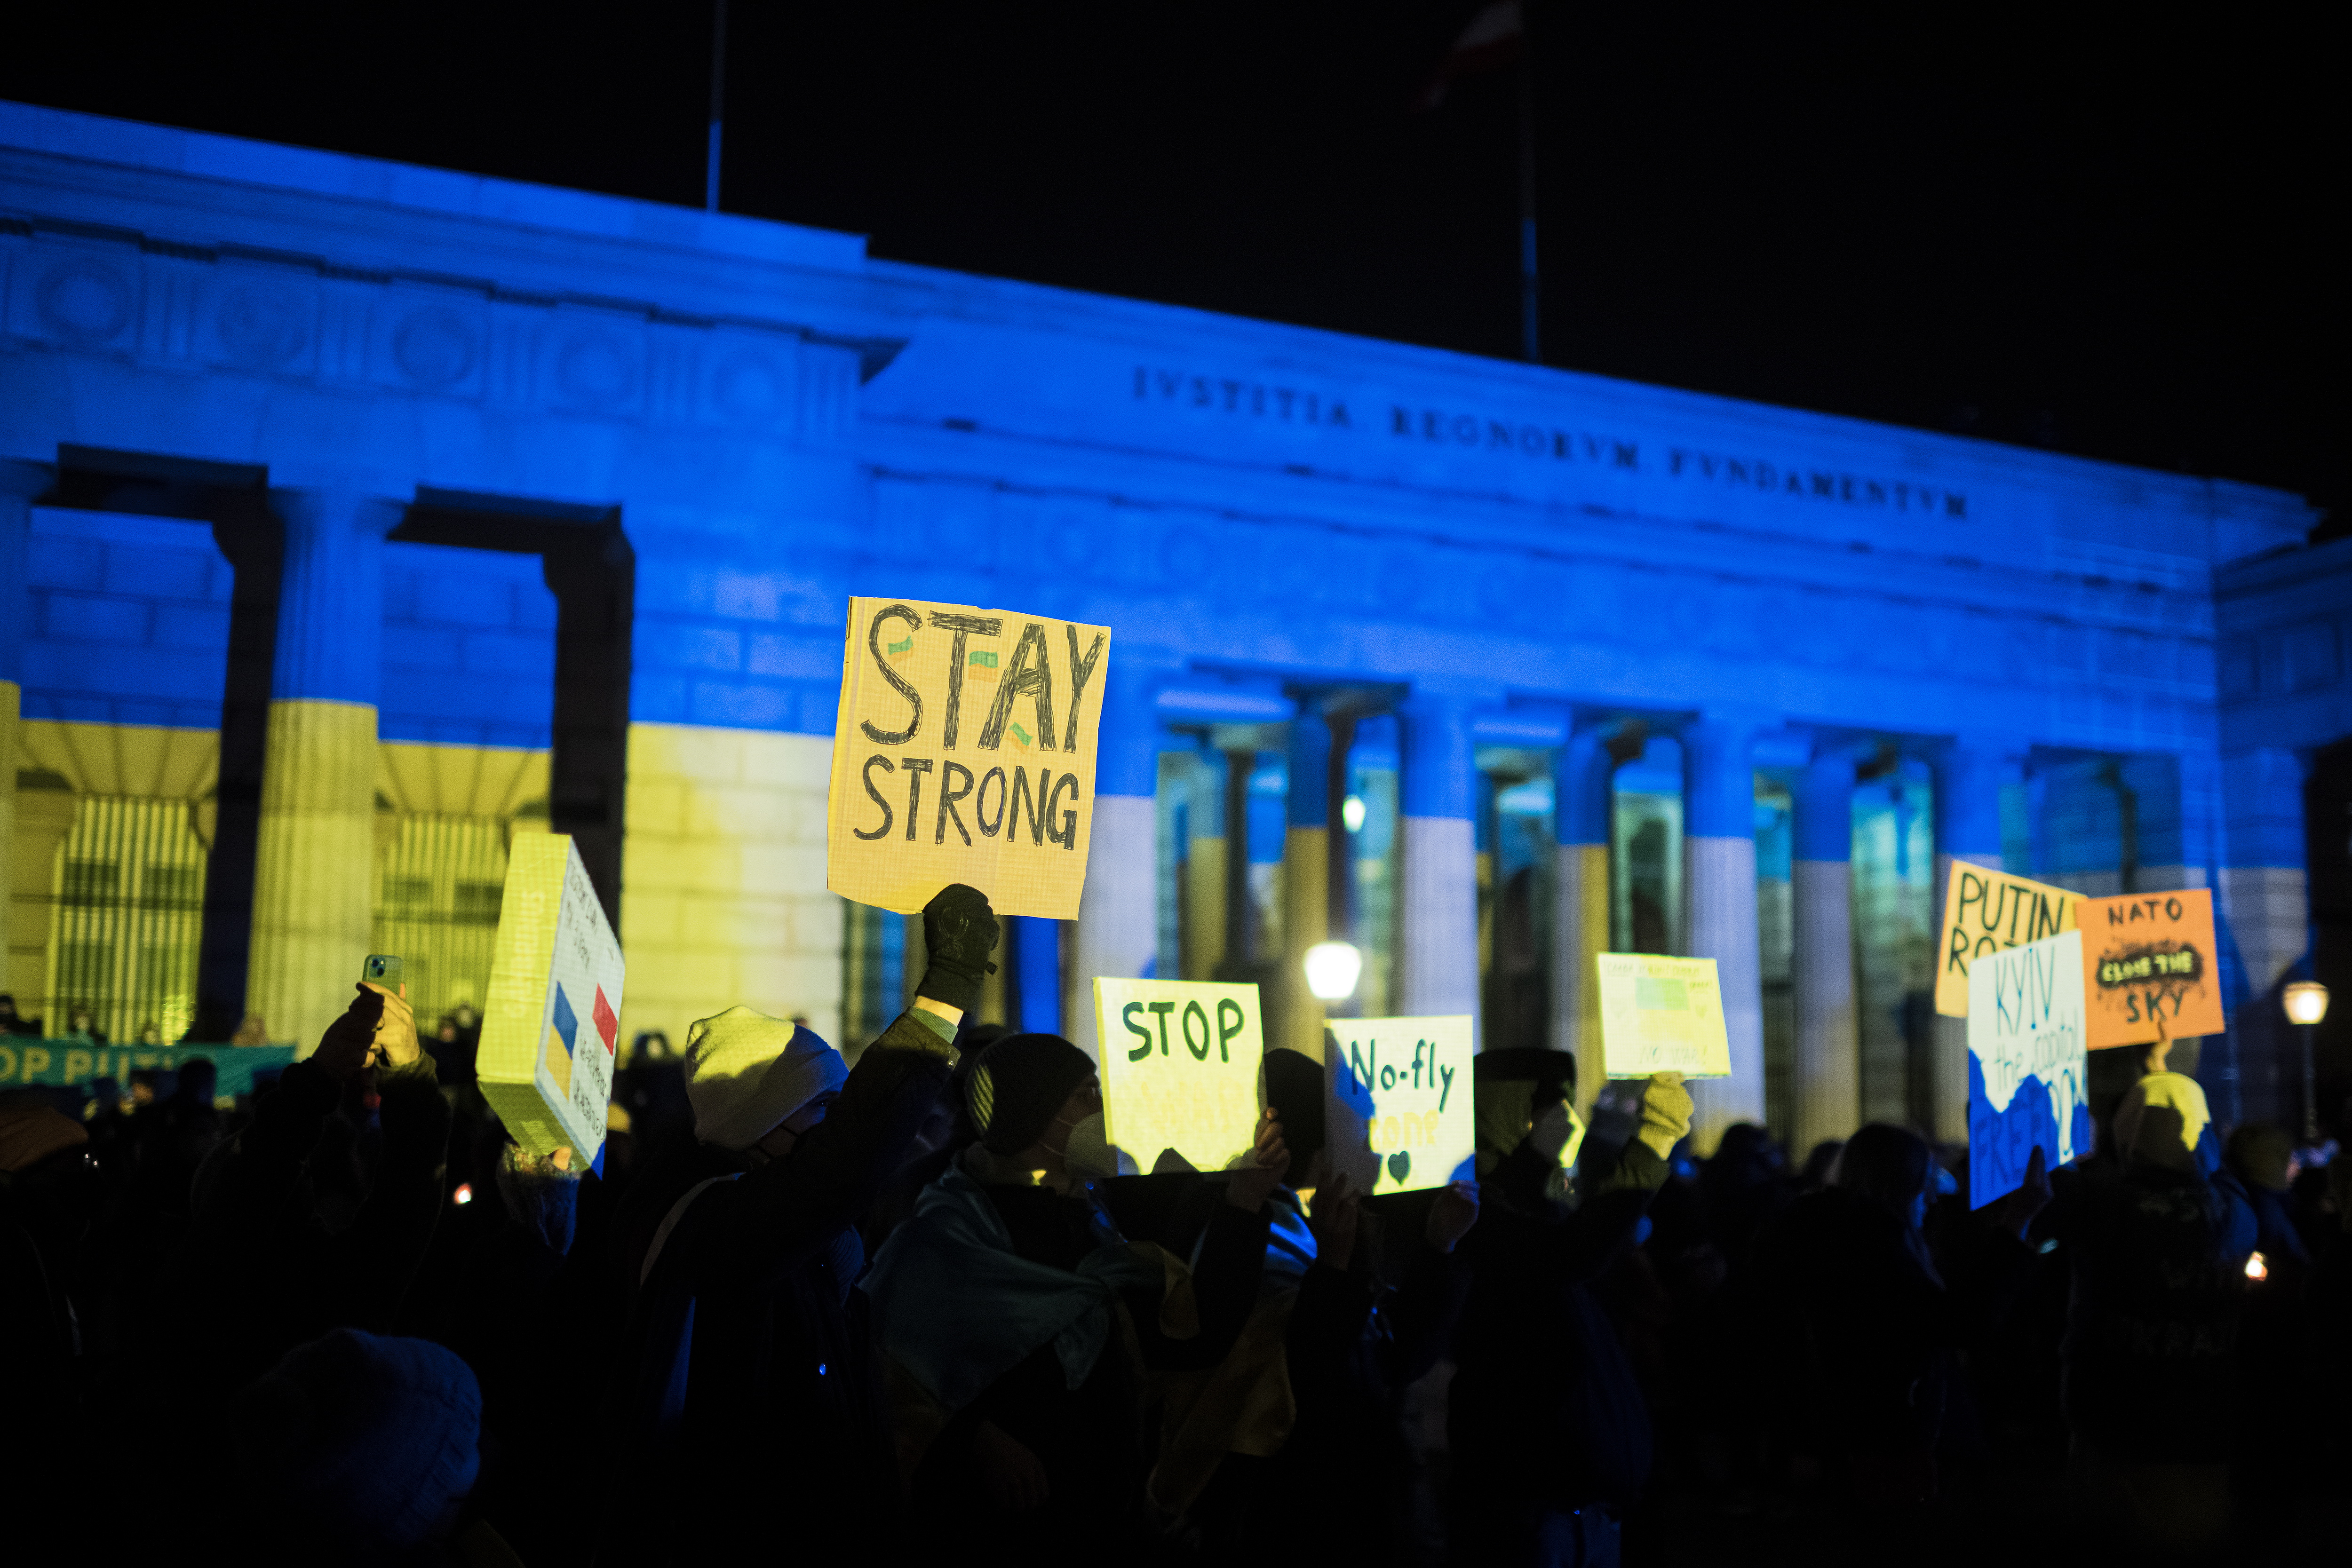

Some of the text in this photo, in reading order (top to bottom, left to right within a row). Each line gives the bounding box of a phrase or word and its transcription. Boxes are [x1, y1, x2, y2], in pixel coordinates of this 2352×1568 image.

[860, 604, 1106, 754] STAY
[853, 754, 1079, 850] STRONG
[1959, 872, 2065, 943] PUTIN
[2108, 896, 2184, 927] NATO
[1995, 942, 2055, 1037] KYIV
[2126, 988, 2186, 1024] SKY
[1122, 998, 1245, 1064] STOP
[1351, 1038, 1454, 1114] No-fly
